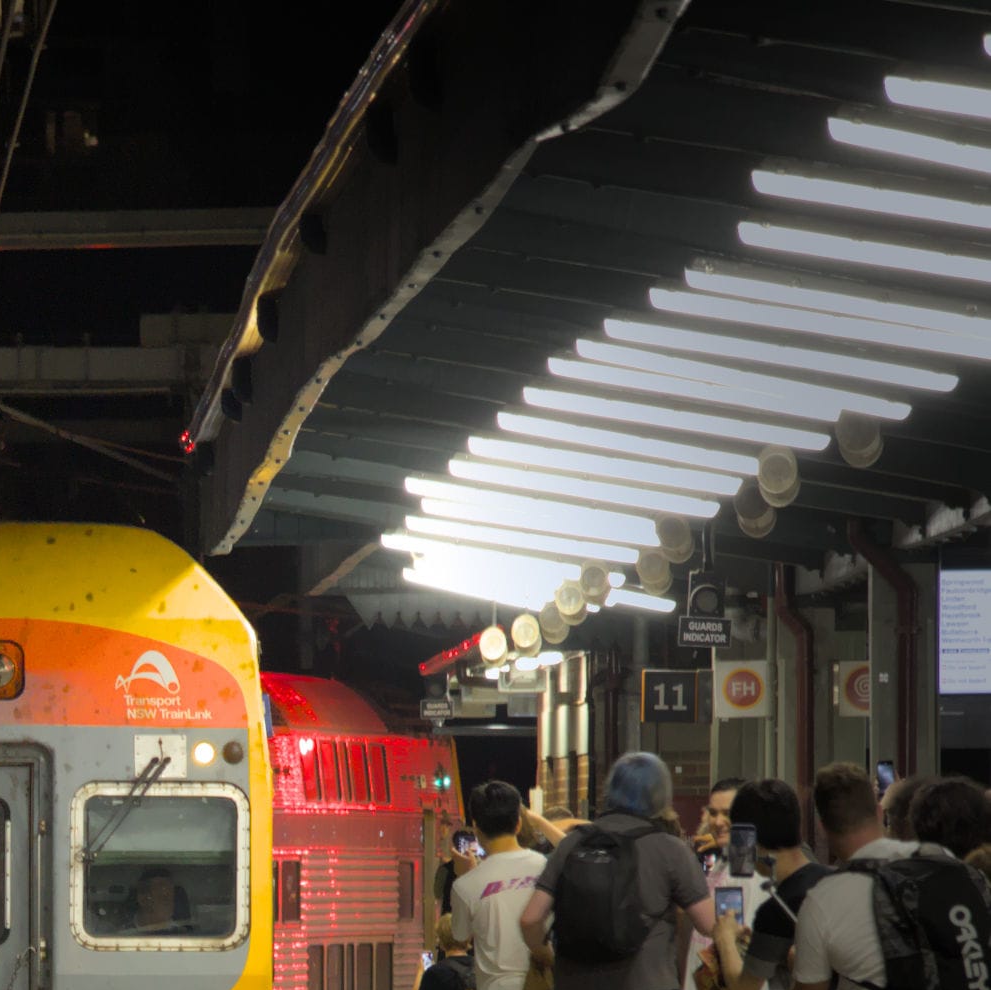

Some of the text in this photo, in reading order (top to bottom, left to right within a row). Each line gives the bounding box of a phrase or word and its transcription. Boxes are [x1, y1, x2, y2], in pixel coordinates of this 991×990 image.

[688, 621, 723, 632] GUARDS
[683, 631, 726, 643] INDICATOR
[124, 694, 181, 708] Transport
[653, 683, 688, 711] 11
[127, 708, 212, 720] NSW TrainLink
